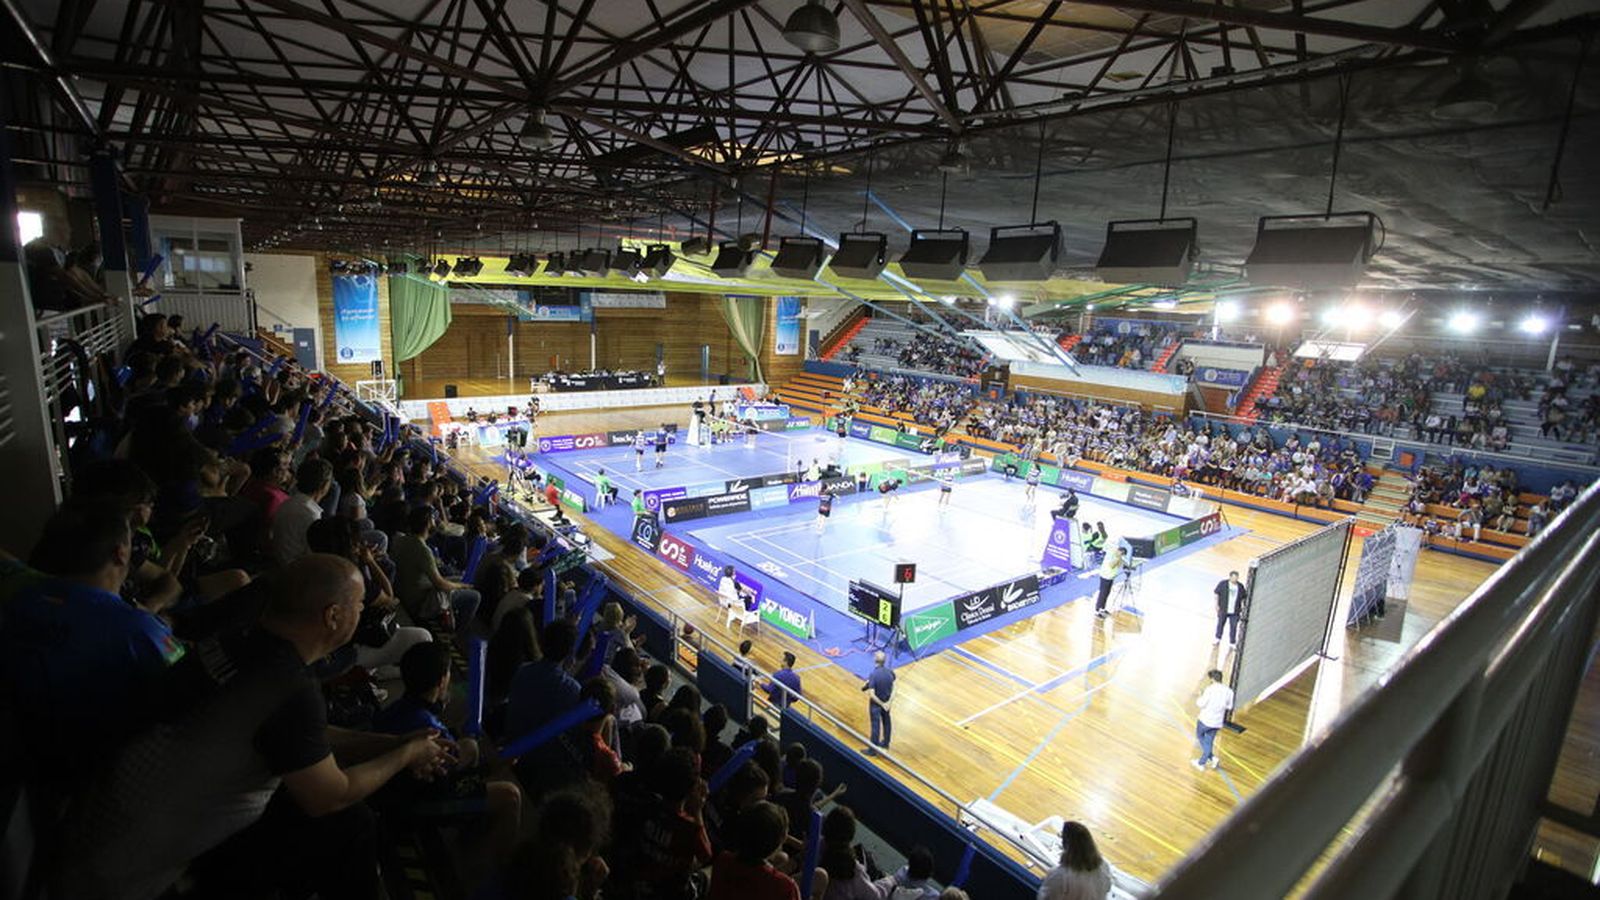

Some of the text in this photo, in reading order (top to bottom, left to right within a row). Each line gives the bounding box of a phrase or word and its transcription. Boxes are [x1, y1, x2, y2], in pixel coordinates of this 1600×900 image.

[882, 602, 889, 611] 2
[779, 605, 808, 631] YONEX
[882, 613, 889, 622] 6
